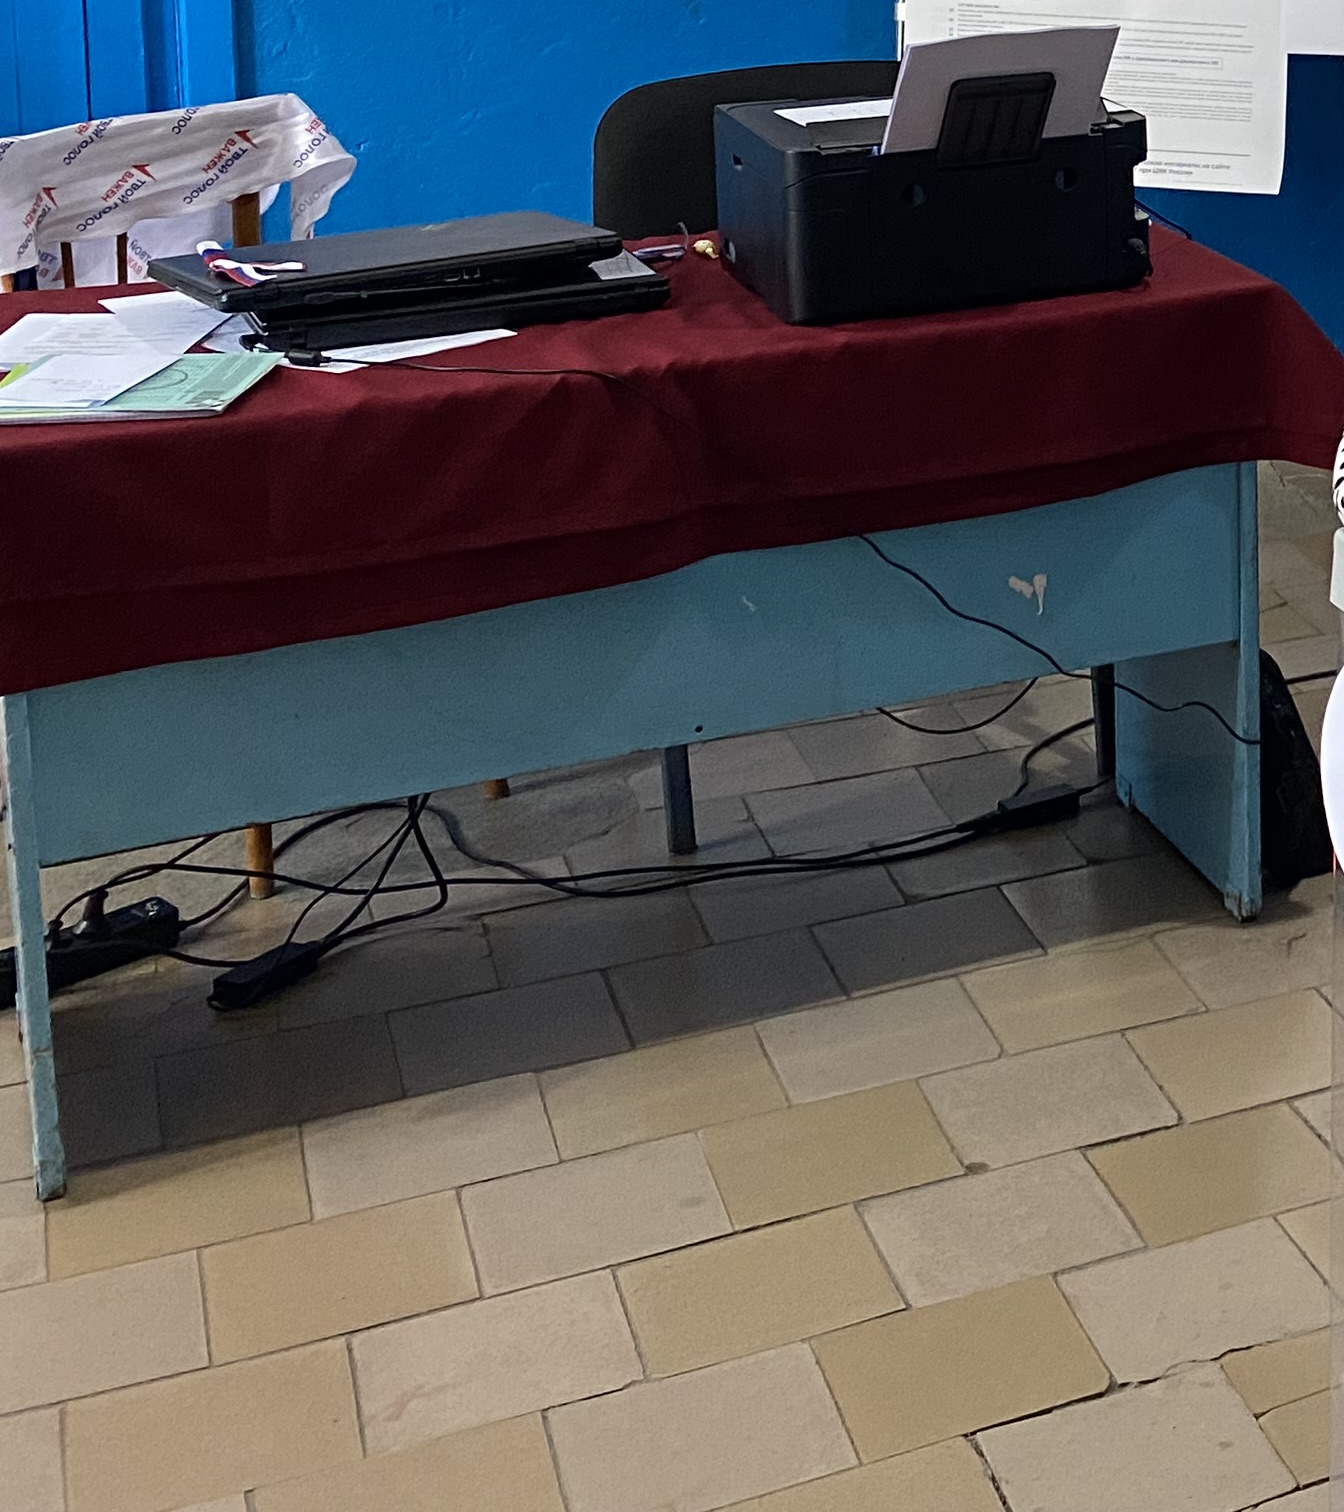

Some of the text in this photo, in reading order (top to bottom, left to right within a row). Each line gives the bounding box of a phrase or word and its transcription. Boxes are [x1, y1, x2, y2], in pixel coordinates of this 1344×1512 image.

[62, 137, 94, 166] ГОЛОС
[202, 138, 237, 174] ВАЖЕН
[101, 170, 135, 202] ВАЖЕН
[183, 146, 248, 205] ТВОЙ ГОЛОС
[76, 179, 147, 232] ТВОЙ ГОЛОС
